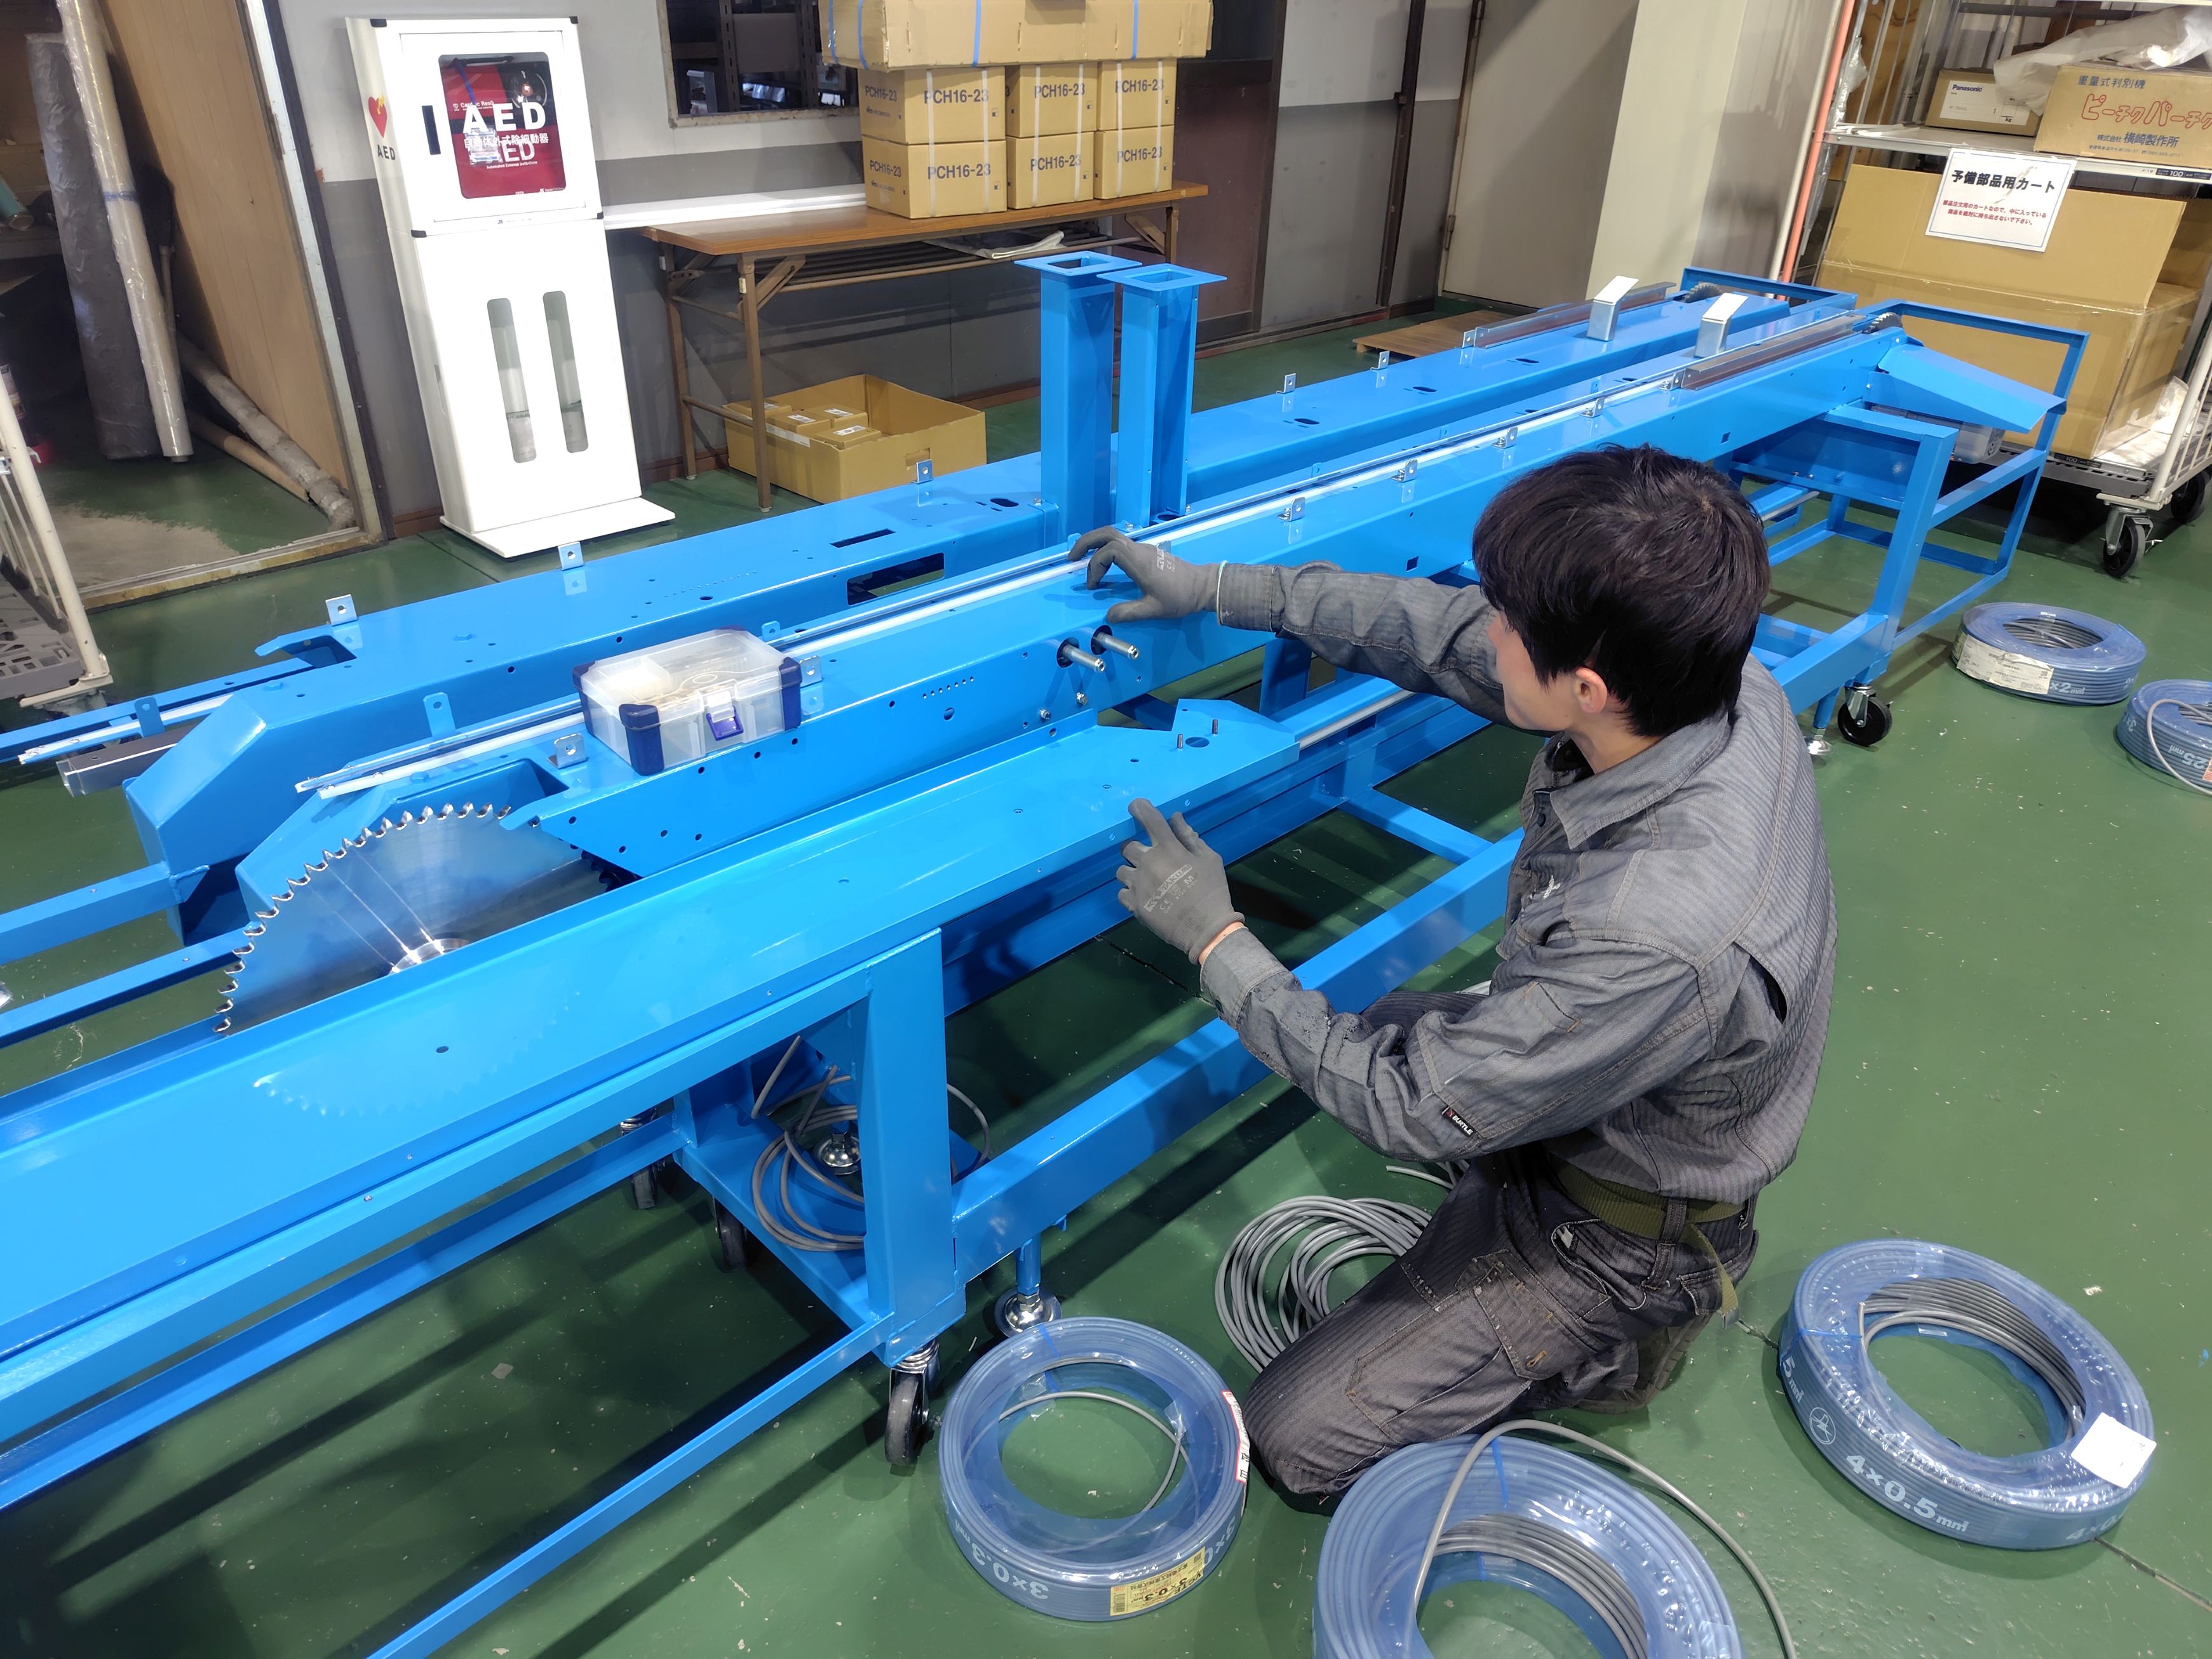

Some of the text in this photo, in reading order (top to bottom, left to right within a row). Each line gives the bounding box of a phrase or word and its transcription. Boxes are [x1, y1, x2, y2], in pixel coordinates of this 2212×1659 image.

[1034, 83, 1085, 98] PCH16-23
[1115, 79, 1164, 93] PCH16-23
[1952, 84, 1983, 92] Panasonic
[2077, 75, 2146, 89] 重量式判別機
[865, 86, 898, 102] PCH16-23
[924, 88, 988, 104] PCH16-23
[462, 102, 546, 133] AED
[2081, 93, 2212, 130] ピーチクパーチク
[2097, 134, 2122, 143] 株式会社
[377, 144, 396, 161] AED
[1117, 146, 1162, 163] PCH16-23
[870, 160, 902, 178] PCH16-23
[1030, 154, 1081, 171] PCH16-23
[927, 163, 991, 180] PCH16-23
[1951, 170, 2055, 193] 予備部品用カート
[1452, 1115, 1473, 1135] BURTLE
[1175, 1571, 1203, 1595] VCTF
